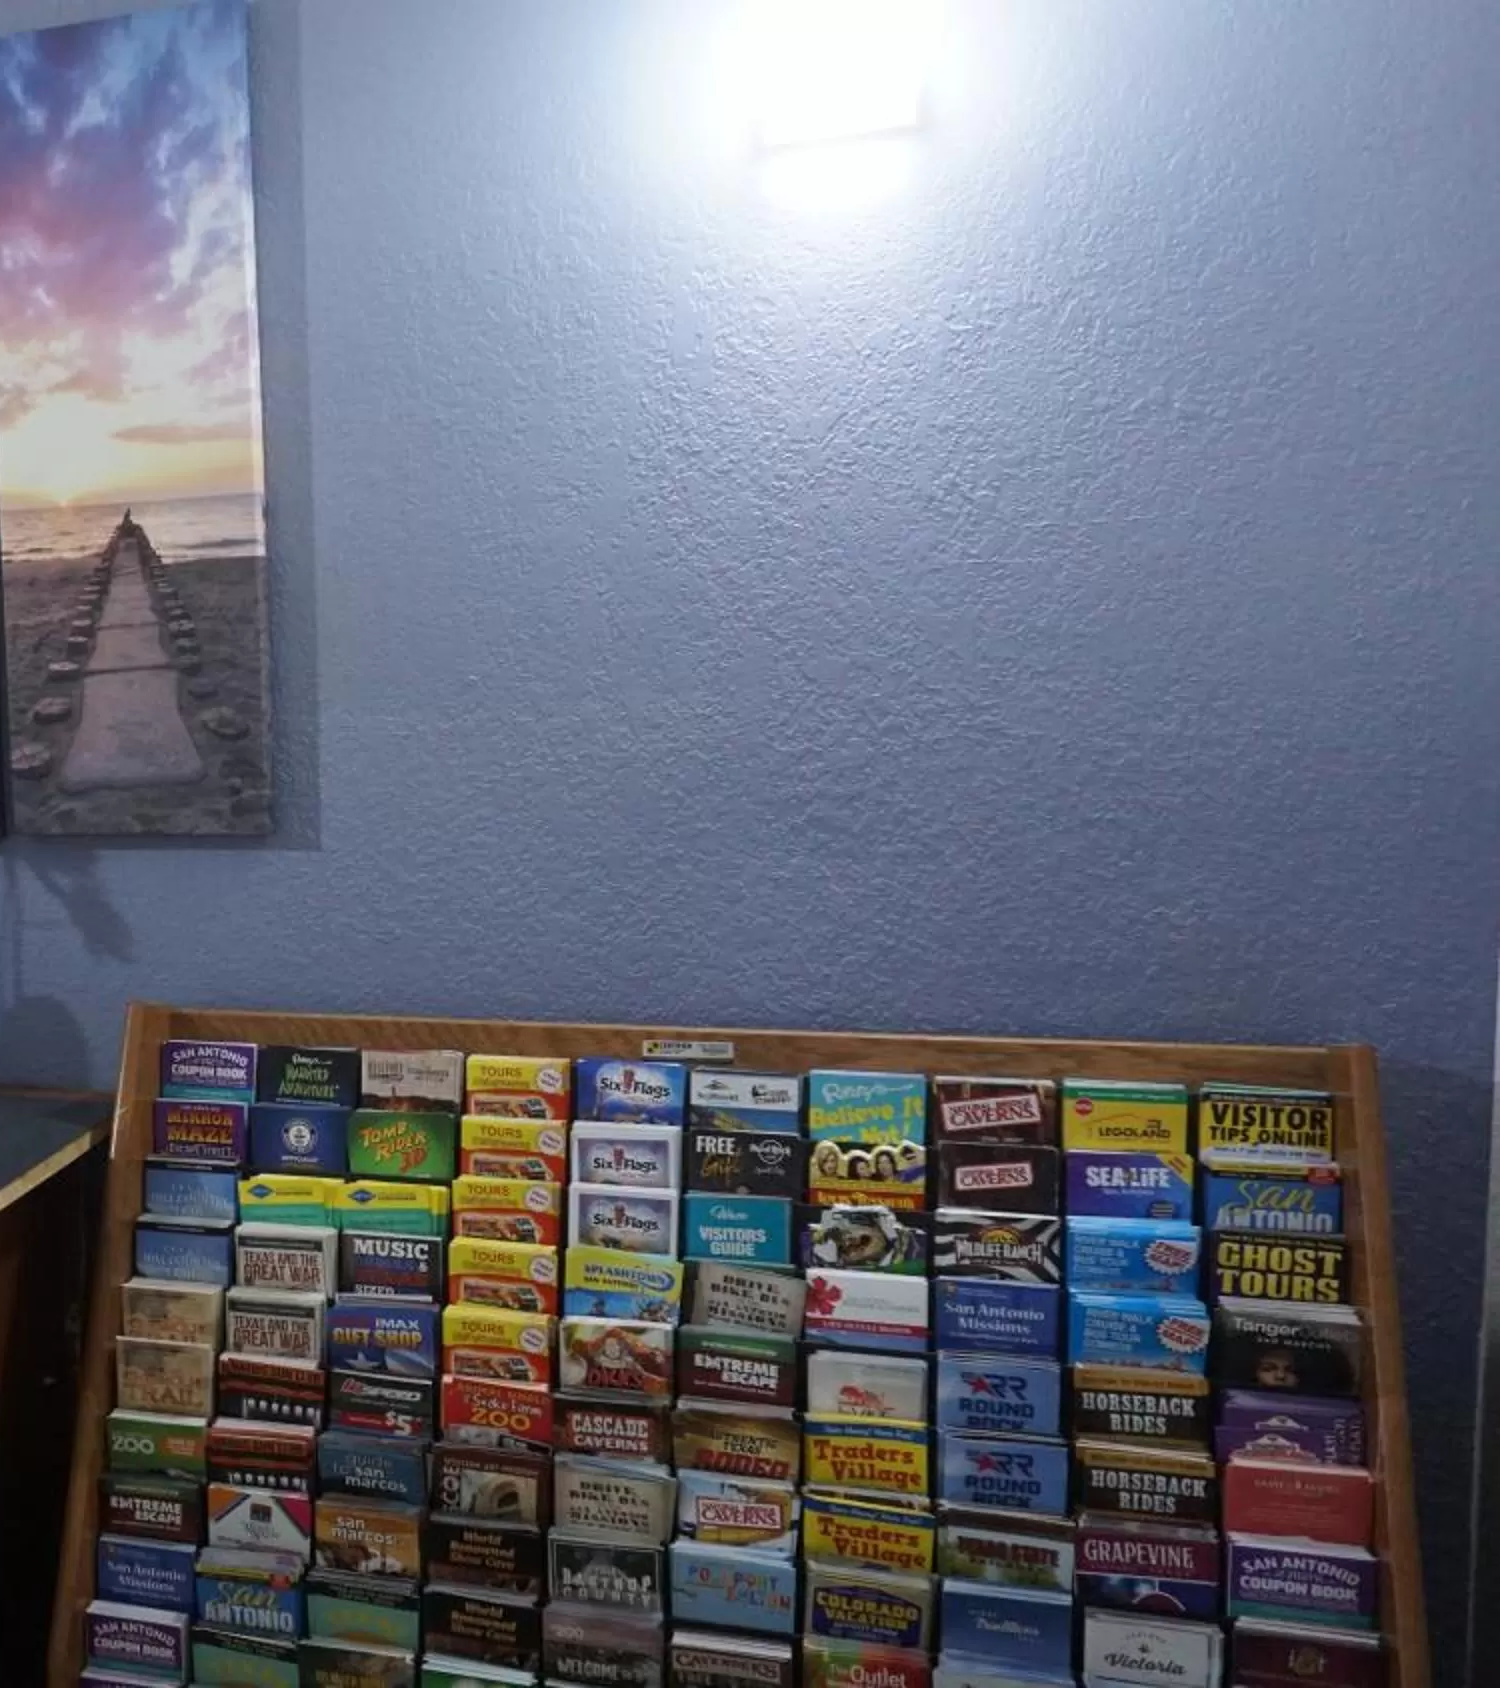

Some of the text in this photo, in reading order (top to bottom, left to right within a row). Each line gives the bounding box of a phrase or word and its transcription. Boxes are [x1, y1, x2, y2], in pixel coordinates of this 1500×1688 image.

[172, 1047, 249, 1067] SAN ANTONIO
[171, 1065, 248, 1080] COUPON BOOK
[481, 1065, 522, 1078] TOURS
[600, 1077, 671, 1098] Six Flags
[810, 1104, 895, 1129] Believe
[950, 1103, 1035, 1126] CAVERNS
[1210, 1103, 1329, 1130] VISITOR
[167, 1126, 233, 1144] MAZE
[480, 1125, 522, 1138] TOURS
[1098, 1126, 1171, 1140] LEGOLAND
[1208, 1125, 1328, 1147] TIPS ONLINE
[376, 1129, 426, 1162] RIDER
[696, 1135, 736, 1155] FREE
[593, 1157, 659, 1173] Six Flags
[959, 1170, 1030, 1187] CAVERNS
[1086, 1166, 1122, 1188] SEA
[468, 1184, 511, 1197] TOURS
[1238, 1180, 1317, 1211] San
[593, 1214, 660, 1232] Six Flags
[1216, 1204, 1333, 1232] ANTONIO
[699, 1226, 767, 1243] VISITORS
[244, 1251, 319, 1266] TEXAS AND THE
[353, 1238, 429, 1260] MUSIC
[472, 1250, 515, 1265] TOURS
[710, 1242, 755, 1257] GUIDE
[1217, 1242, 1342, 1275] GHOST
[244, 1263, 320, 1284] GREAT WAR
[1217, 1271, 1340, 1302] TOURS
[944, 1302, 1045, 1321] San Antonio
[234, 1315, 264, 1328] TEXAS
[267, 1318, 289, 1331] AND
[375, 1318, 420, 1331] IMAX
[461, 1321, 506, 1335] TOURS
[959, 1317, 1032, 1334] Missions
[1234, 1317, 1299, 1337] Tanger
[234, 1328, 311, 1349] GREAT WAR
[333, 1328, 423, 1348] GIFT SHOP
[959, 1397, 1035, 1419] ROUND
[1082, 1391, 1196, 1418] HORSEBACK
[470, 1408, 531, 1431] ZOO
[571, 1413, 649, 1438] CASCADE
[1109, 1413, 1167, 1435] RIDES
[112, 1436, 154, 1455] ZOO
[573, 1435, 649, 1452] CAVERNS
[813, 1439, 915, 1464] Traders
[355, 1467, 385, 1478] san
[830, 1460, 922, 1489] Village
[345, 1475, 407, 1493] marcos
[965, 1474, 1041, 1495] ROUND
[1091, 1470, 1207, 1498] HORSEBACK
[1118, 1491, 1176, 1515] RIDES
[336, 1516, 366, 1529] san
[702, 1508, 778, 1527] CAVERNS
[331, 1526, 396, 1546] marcos
[817, 1516, 920, 1547] Traders
[832, 1537, 926, 1569] Village
[1084, 1539, 1194, 1569] GRAPEVINE
[134, 1563, 186, 1581] Antonio
[1243, 1555, 1360, 1586] SAN ANTONIO
[1240, 1575, 1358, 1601] COUPON BOOK
[816, 1590, 919, 1621] COLORADO
[205, 1602, 294, 1633] ANTONIO
[824, 1606, 910, 1631] VACATION
[95, 1621, 175, 1646] SAN ANTONIO
[94, 1637, 140, 1654] COUPON
[1103, 1651, 1188, 1677] Victoria
[851, 1664, 906, 1687] Outlet
